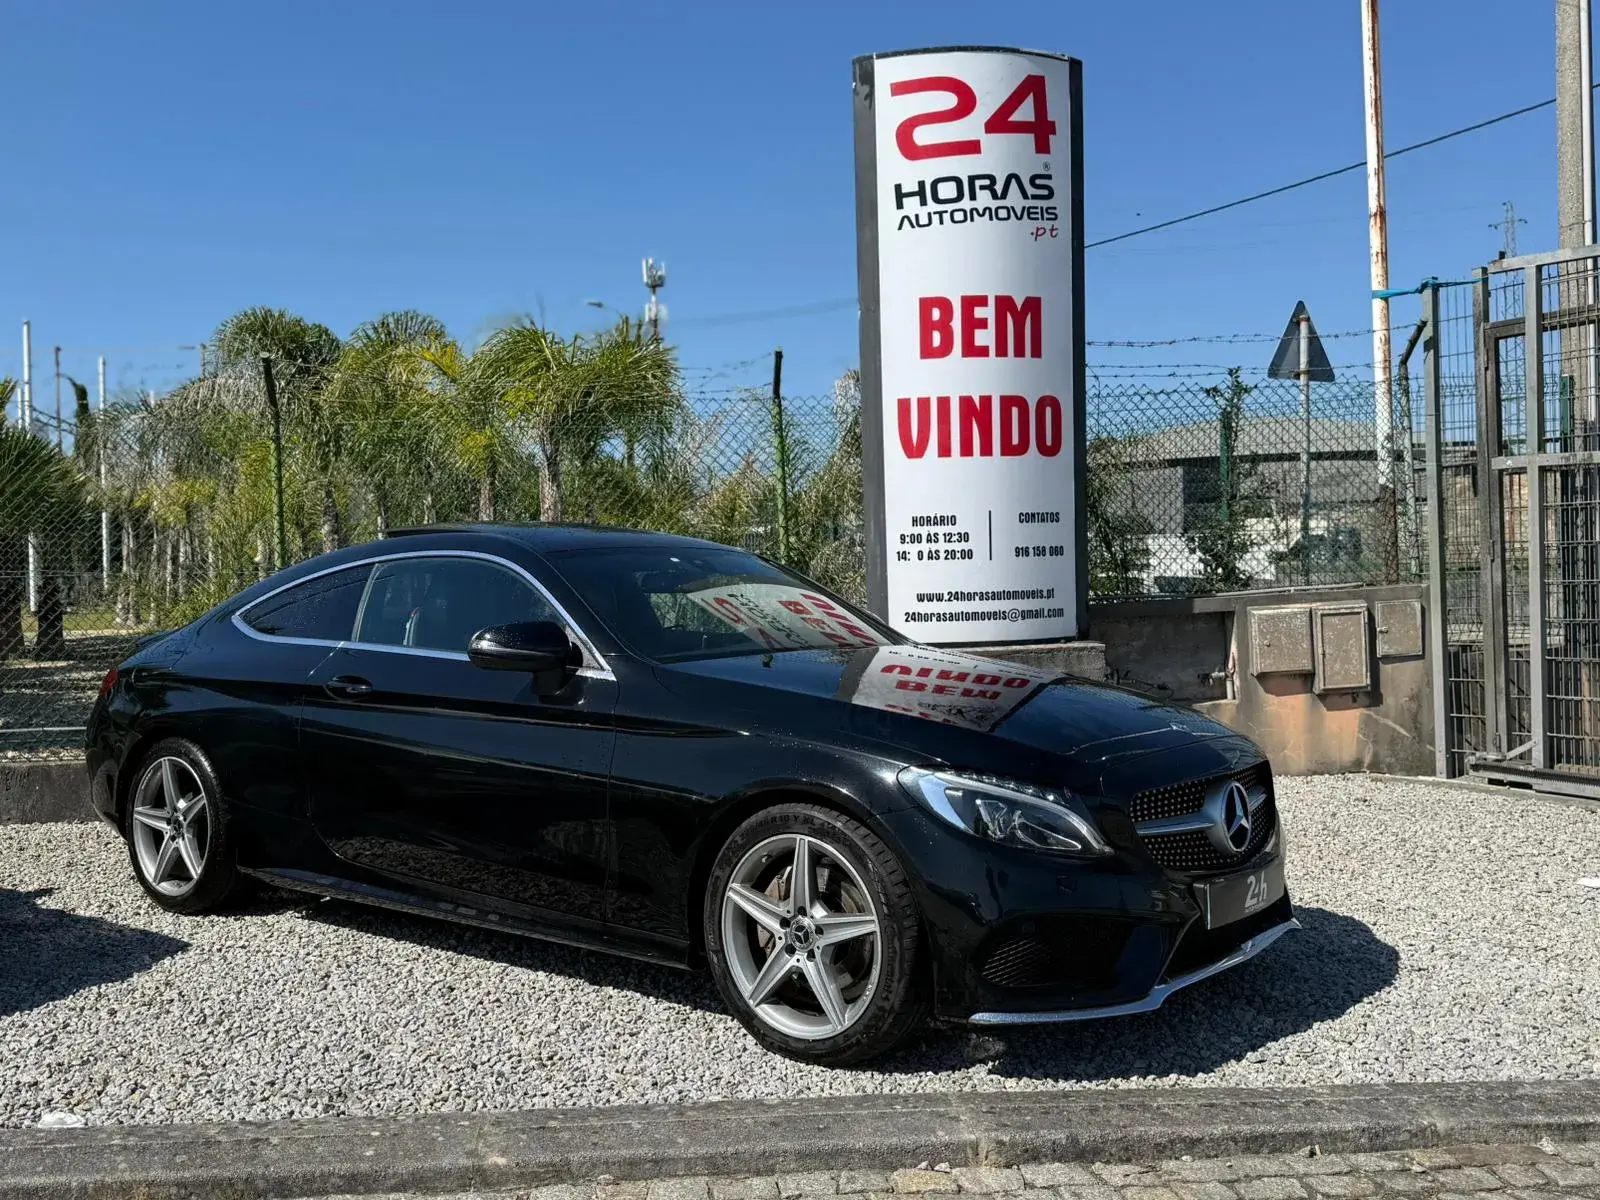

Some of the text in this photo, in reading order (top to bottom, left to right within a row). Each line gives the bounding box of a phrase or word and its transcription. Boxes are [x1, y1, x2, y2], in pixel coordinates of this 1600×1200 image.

[890, 74, 1056, 161] 24
[894, 172, 1055, 210] HORAS
[897, 205, 1059, 231] AUTOMOVEIS
[1030, 223, 1059, 242] .pt
[918, 294, 1043, 360] BEM
[896, 394, 1063, 460] VINDO
[912, 512, 957, 527] HORÁRIO
[1018, 511, 1060, 524] CONTATOS
[900, 533, 923, 544] 9:00
[942, 531, 970, 543] 12:30
[943, 548, 974, 560] 20:00
[1015, 546, 1030, 558] 916
[1032, 545, 1047, 558] 158
[916, 587, 1055, 603] www.24horasautomoveis.pt
[904, 607, 1064, 623] 24horasautomoveis@gmail.com
